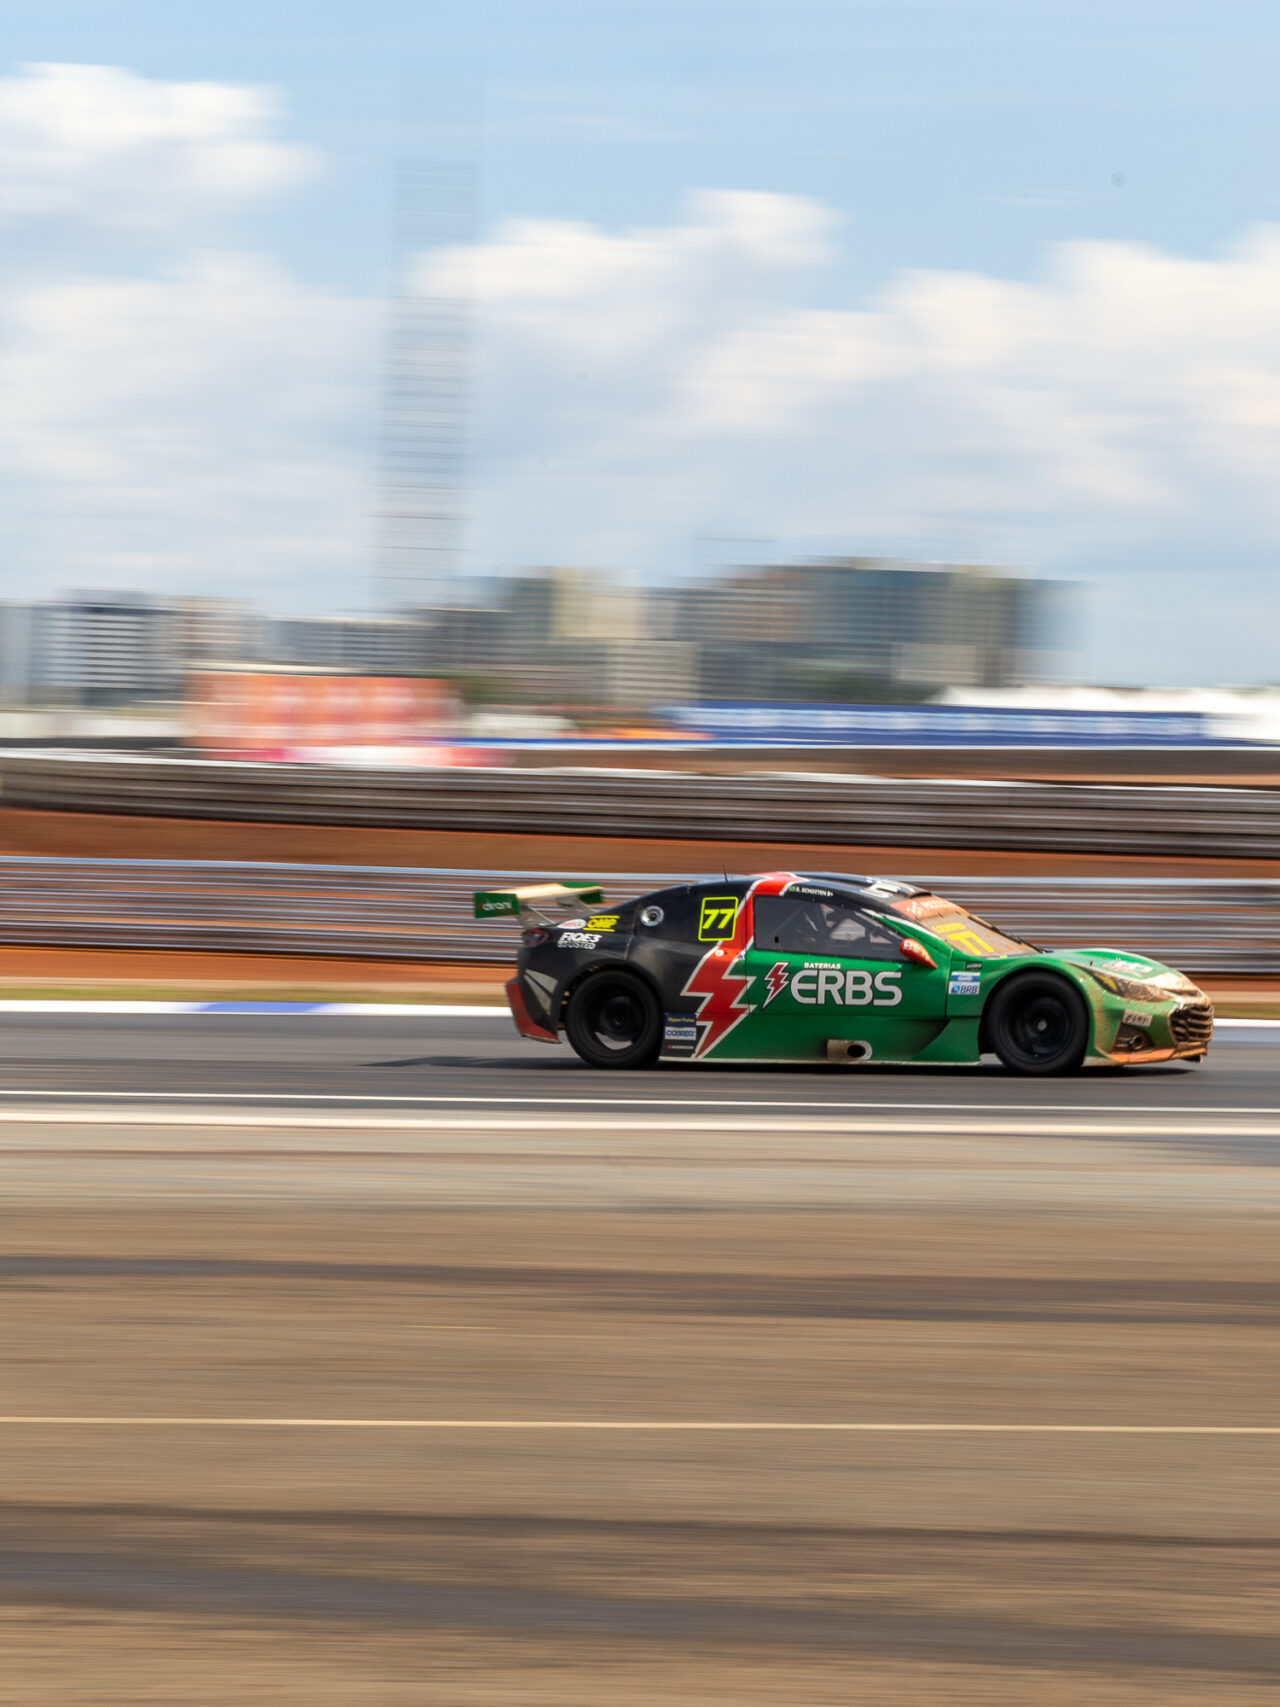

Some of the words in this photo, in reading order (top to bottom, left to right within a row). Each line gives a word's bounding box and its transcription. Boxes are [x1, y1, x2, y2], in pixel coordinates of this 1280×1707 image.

[702, 908, 735, 929] 77
[803, 961, 841, 970] BATERIAS
[790, 969, 903, 1006] ERBS
[960, 984, 978, 995] BRB
